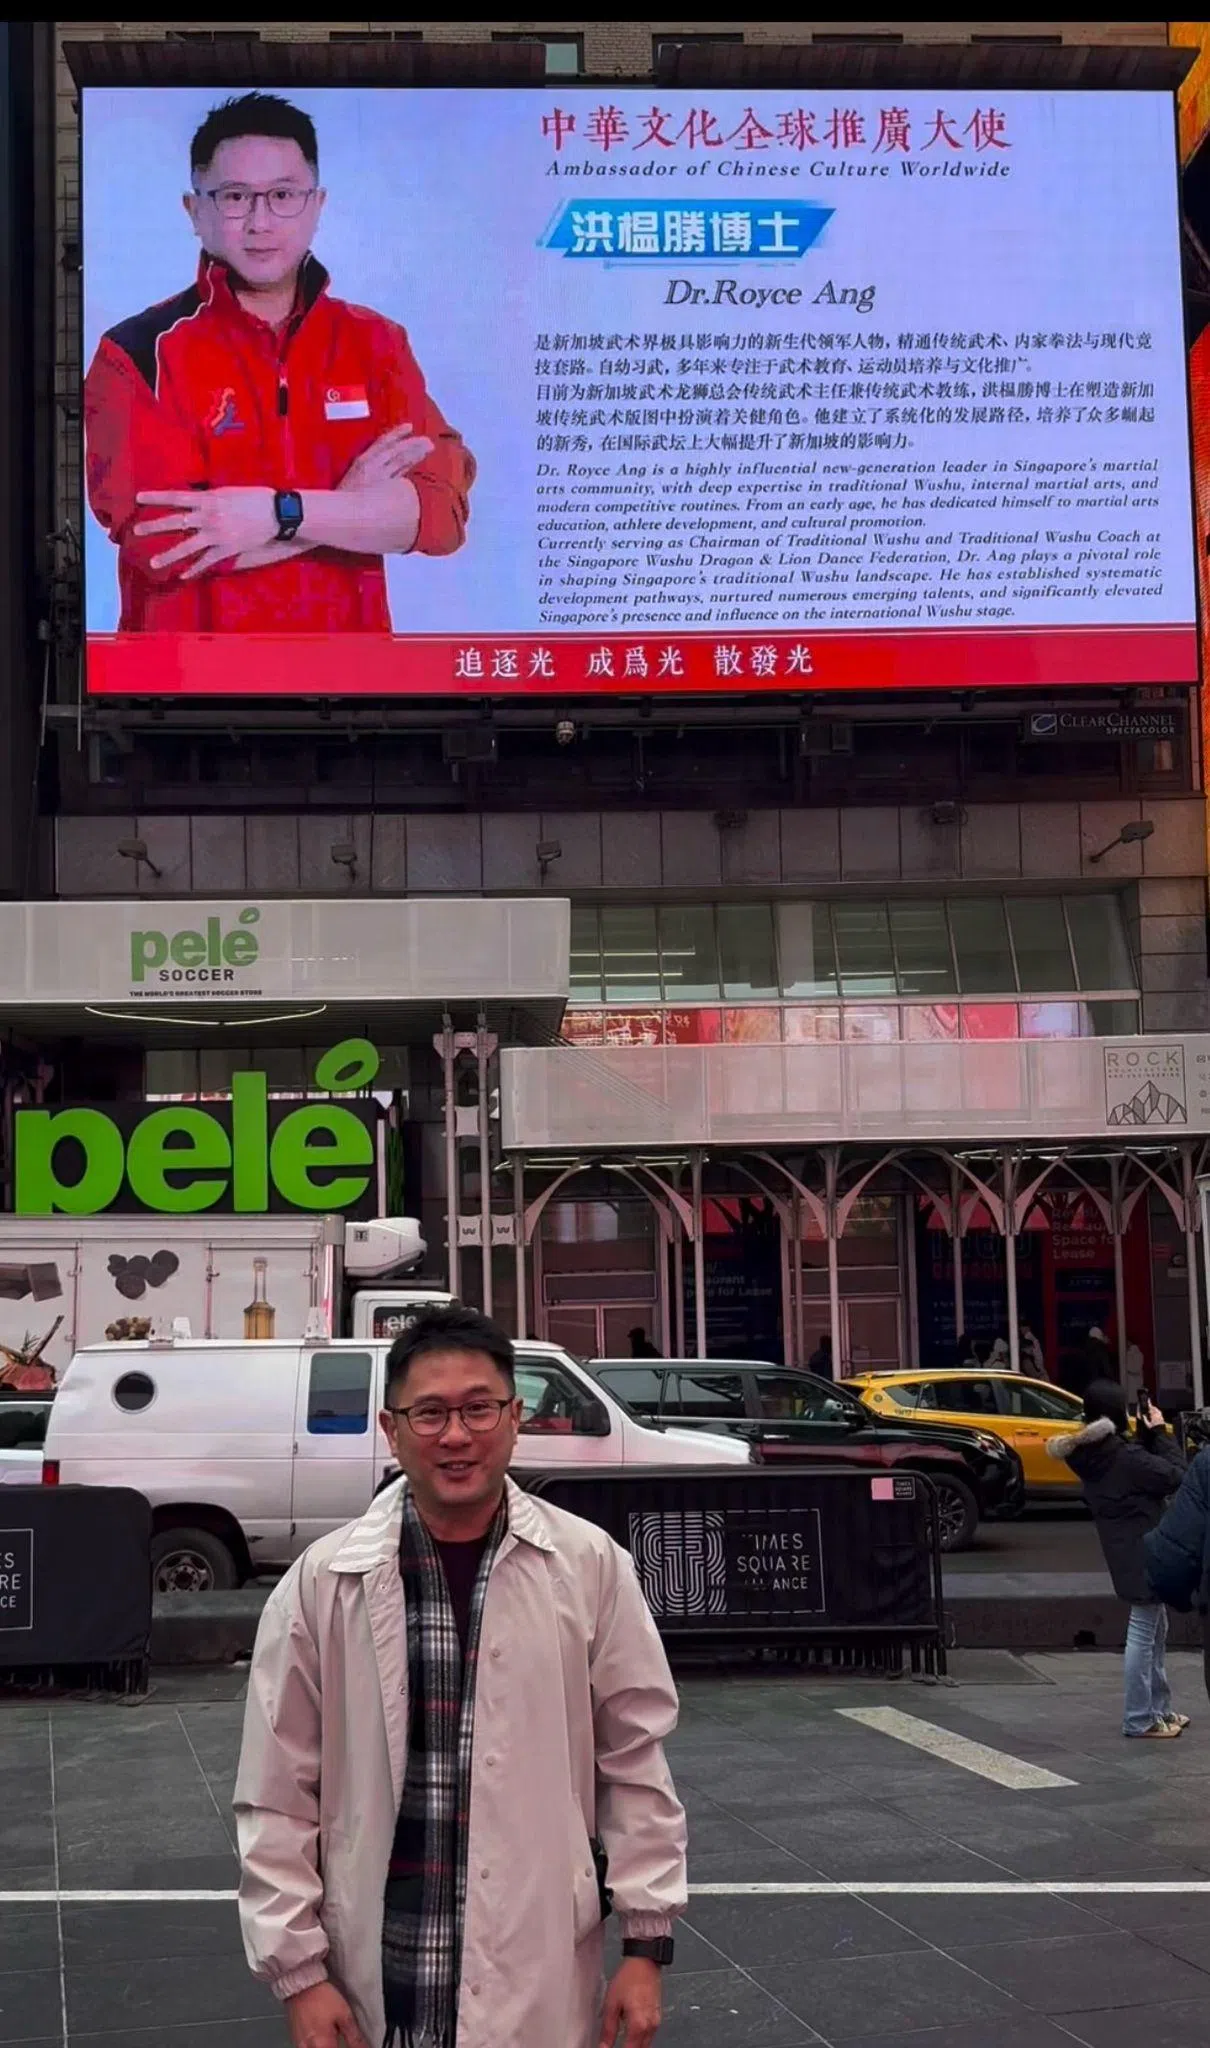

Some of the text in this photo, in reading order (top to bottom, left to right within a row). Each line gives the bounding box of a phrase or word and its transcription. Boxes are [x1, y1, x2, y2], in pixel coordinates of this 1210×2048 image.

[541, 105, 1013, 153] 中華文化全球推廣大使
[545, 160, 1011, 177] Ambassador of Chinese Culture Worldwide
[663, 279, 876, 312] Dr.Royce Ang
[535, 459, 1158, 479] Dr. Royce Ang is a highly influential new-generation leader in Singapore's martial
[535, 477, 1159, 497] arts community, with deep expertise in traditional Wushu, internal martial arts, and
[536, 495, 1159, 515] modern competitive routines. From an early age, he has dedicated himself to martial arts
[536, 515, 926, 533] education, athlete development, and cultural promotion.
[537, 530, 1161, 553] Currently serving as Chairman of Traditional Wushu and Traditional Wushu Coach at
[537, 548, 1161, 571] the Singapore Wushu Dragon & Lion Dance Federation, Dr. Ang plays a pivotal role
[537, 566, 1162, 588] in shaping Singapore's traditional Wushu landscape. He has established systematic
[537, 584, 1163, 608] development pathways, nurtured numerous emerging talents, and significantly elevated
[538, 605, 1015, 625] Singapore's presence and influence on the international Wushu stage.
[454, 648, 557, 679] 追逐光
[713, 644, 815, 676] 散發光
[1105, 726, 1175, 735] SPECTACOLOR
[130, 906, 261, 982] pelé
[159, 968, 235, 982] SOCCER
[1106, 1051, 1179, 1067] ROCK
[15, 1038, 380, 1216] pelé
[1051, 1234, 1097, 1247] Space
[1051, 1247, 1097, 1260] Lease
